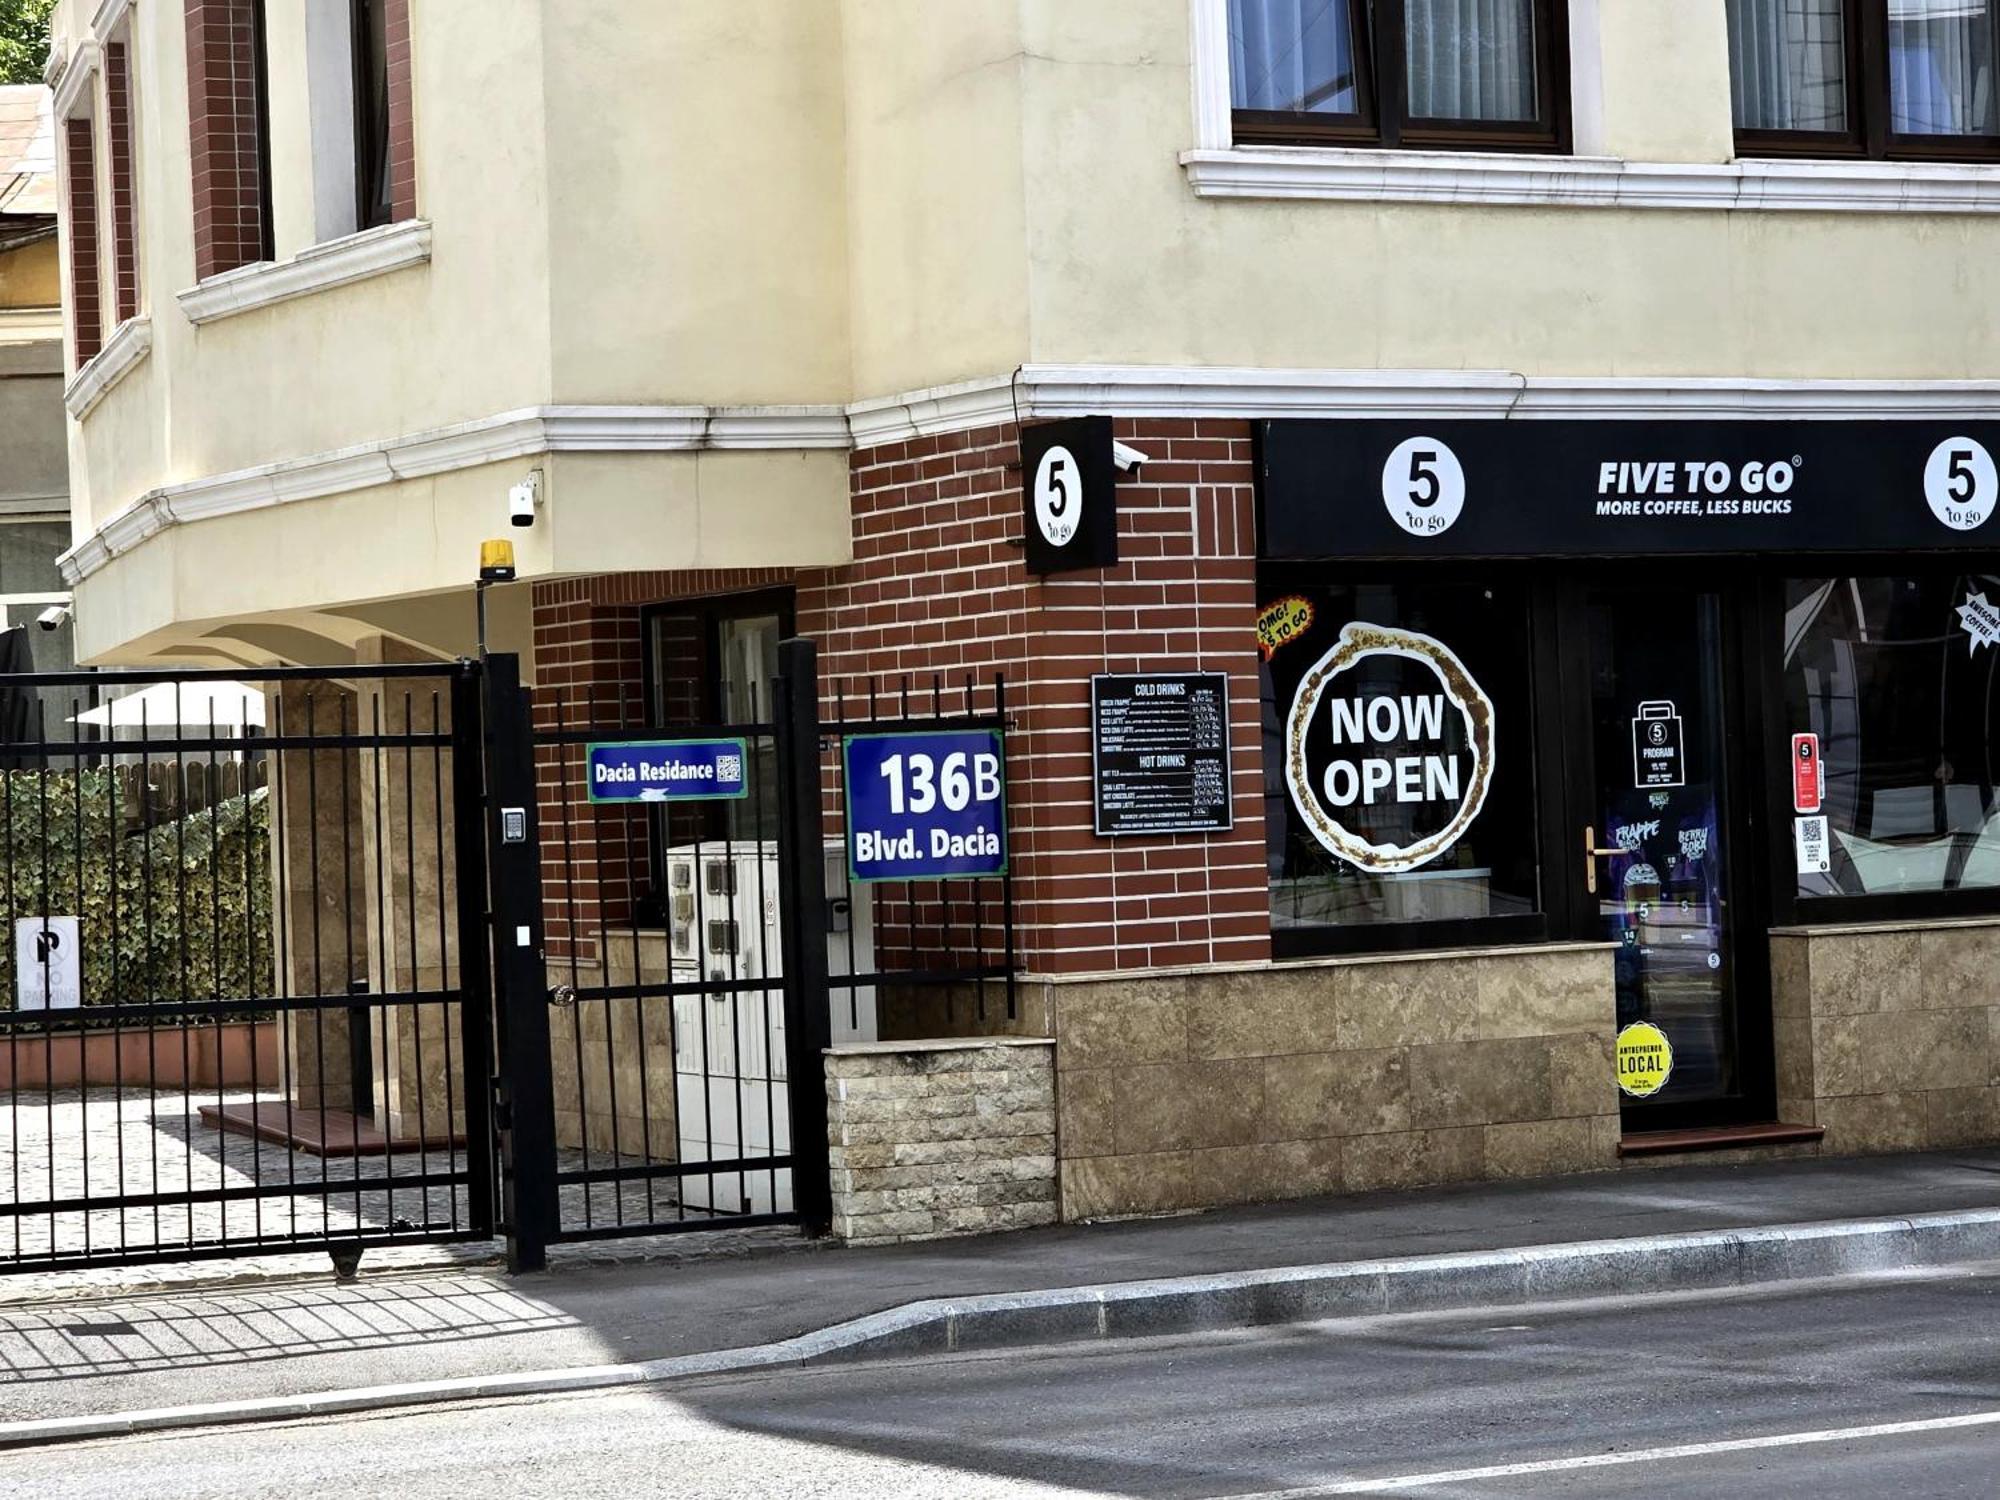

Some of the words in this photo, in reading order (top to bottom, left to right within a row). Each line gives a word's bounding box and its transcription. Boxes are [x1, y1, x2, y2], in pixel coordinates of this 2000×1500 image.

[1048, 460, 1067, 518] 5
[1408, 451, 1441, 508] 5
[1598, 462, 1676, 494] FIVE
[1684, 461, 1731, 494] TO
[1947, 450, 1977, 504] 5
[1596, 500, 1641, 516] MORE
[1643, 500, 1704, 517] COFFEE,
[1706, 500, 1740, 515] LESS
[1742, 499, 1793, 515] BUCKS
[1945, 506, 1961, 523] to
[1964, 510, 1981, 527] go
[1405, 511, 1424, 529] to
[1427, 514, 1446, 533] go
[1258, 602, 1290, 633] OMG!
[1276, 622, 1292, 639] TO
[1292, 608, 1308, 628] GO
[1965, 613, 1993, 639] COFFEE!
[1135, 684, 1156, 697] COLD
[1156, 683, 1186, 696] DRINKS
[1331, 694, 1444, 744] NOW
[1653, 724, 1663, 738] 5
[1139, 755, 1155, 769] HOT
[1156, 754, 1187, 768] DRINKS
[1643, 746, 1675, 759] PROGRAM
[1801, 743, 1810, 757] 5
[595, 762, 636, 783] Dacia
[639, 759, 714, 782] Residance
[880, 751, 1001, 814] 136B
[1323, 755, 1460, 807] OPEN
[856, 828, 924, 862] Blvd.
[930, 825, 1000, 859] Dacia
[1615, 819, 1660, 844] FRAPPE
[1639, 902, 1649, 919] 5
[1619, 1055, 1664, 1074] LOCAL
